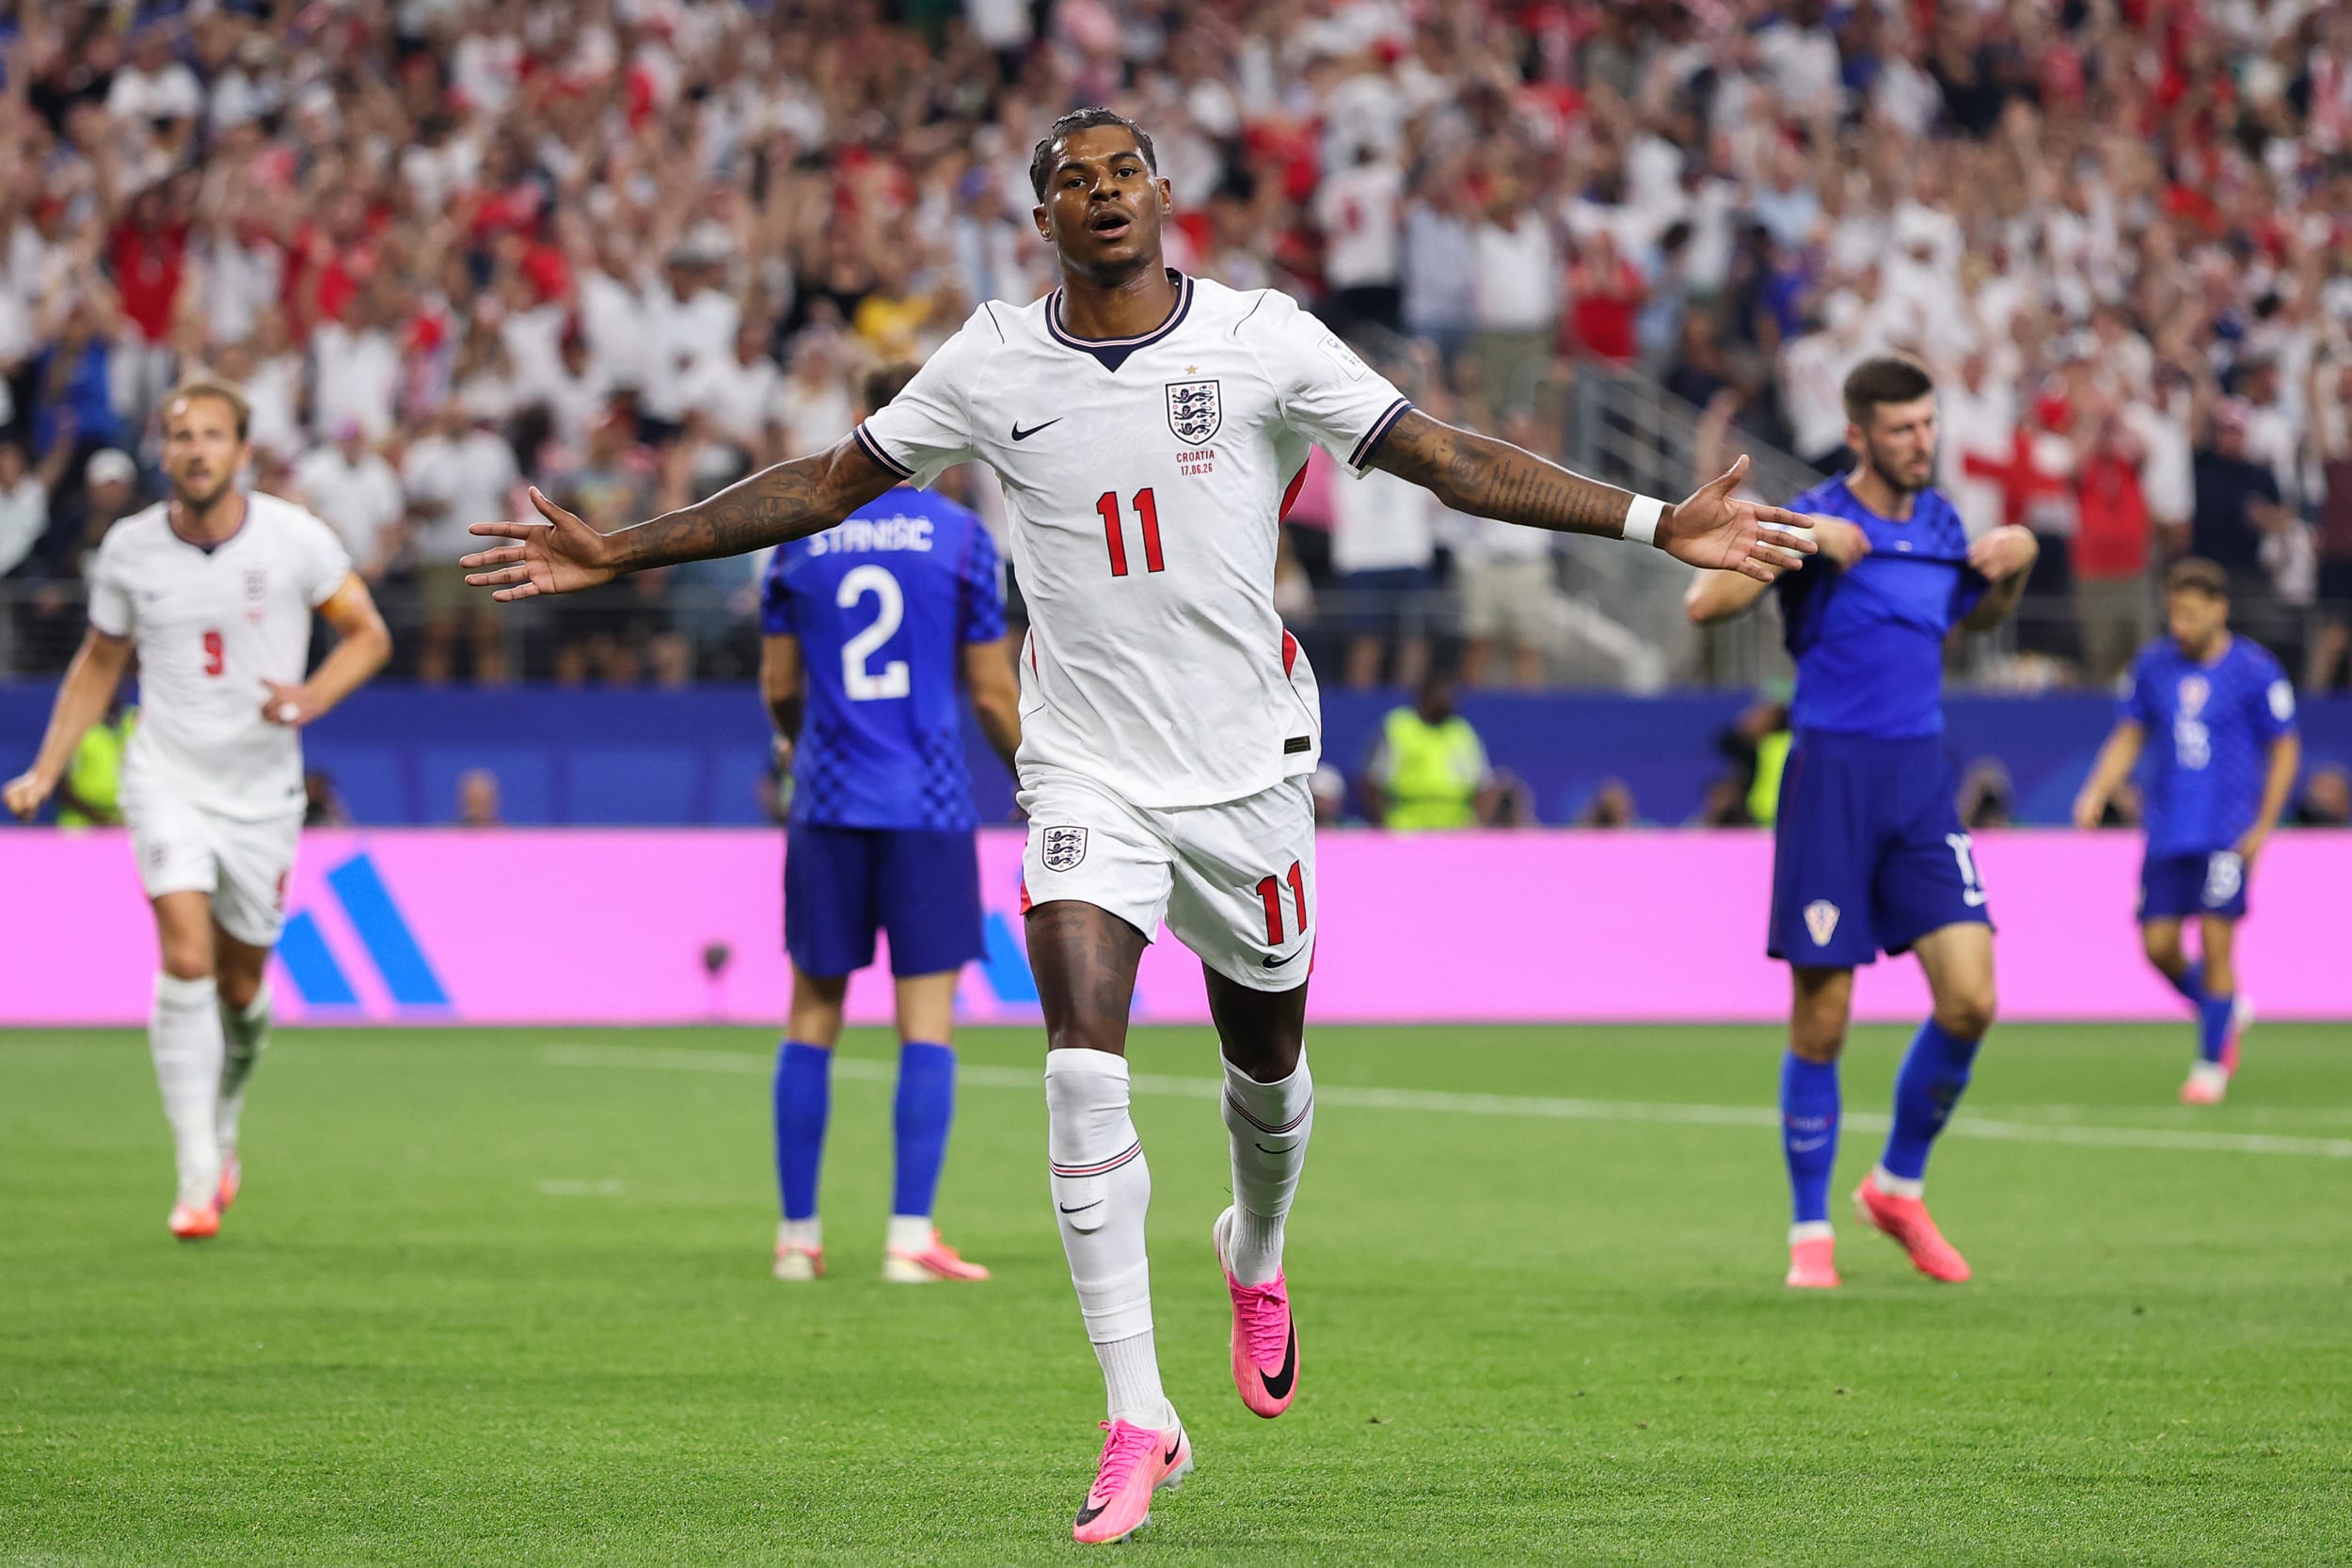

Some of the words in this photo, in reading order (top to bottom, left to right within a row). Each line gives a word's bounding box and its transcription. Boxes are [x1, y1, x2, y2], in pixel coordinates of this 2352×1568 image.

[1176, 450, 1215, 463] CROATIA
[1181, 463, 1213, 476] 17.06.26
[1096, 487, 1165, 577] 11
[203, 630, 224, 676] 9
[836, 564, 911, 700] 2
[1256, 859, 1308, 946] 11
